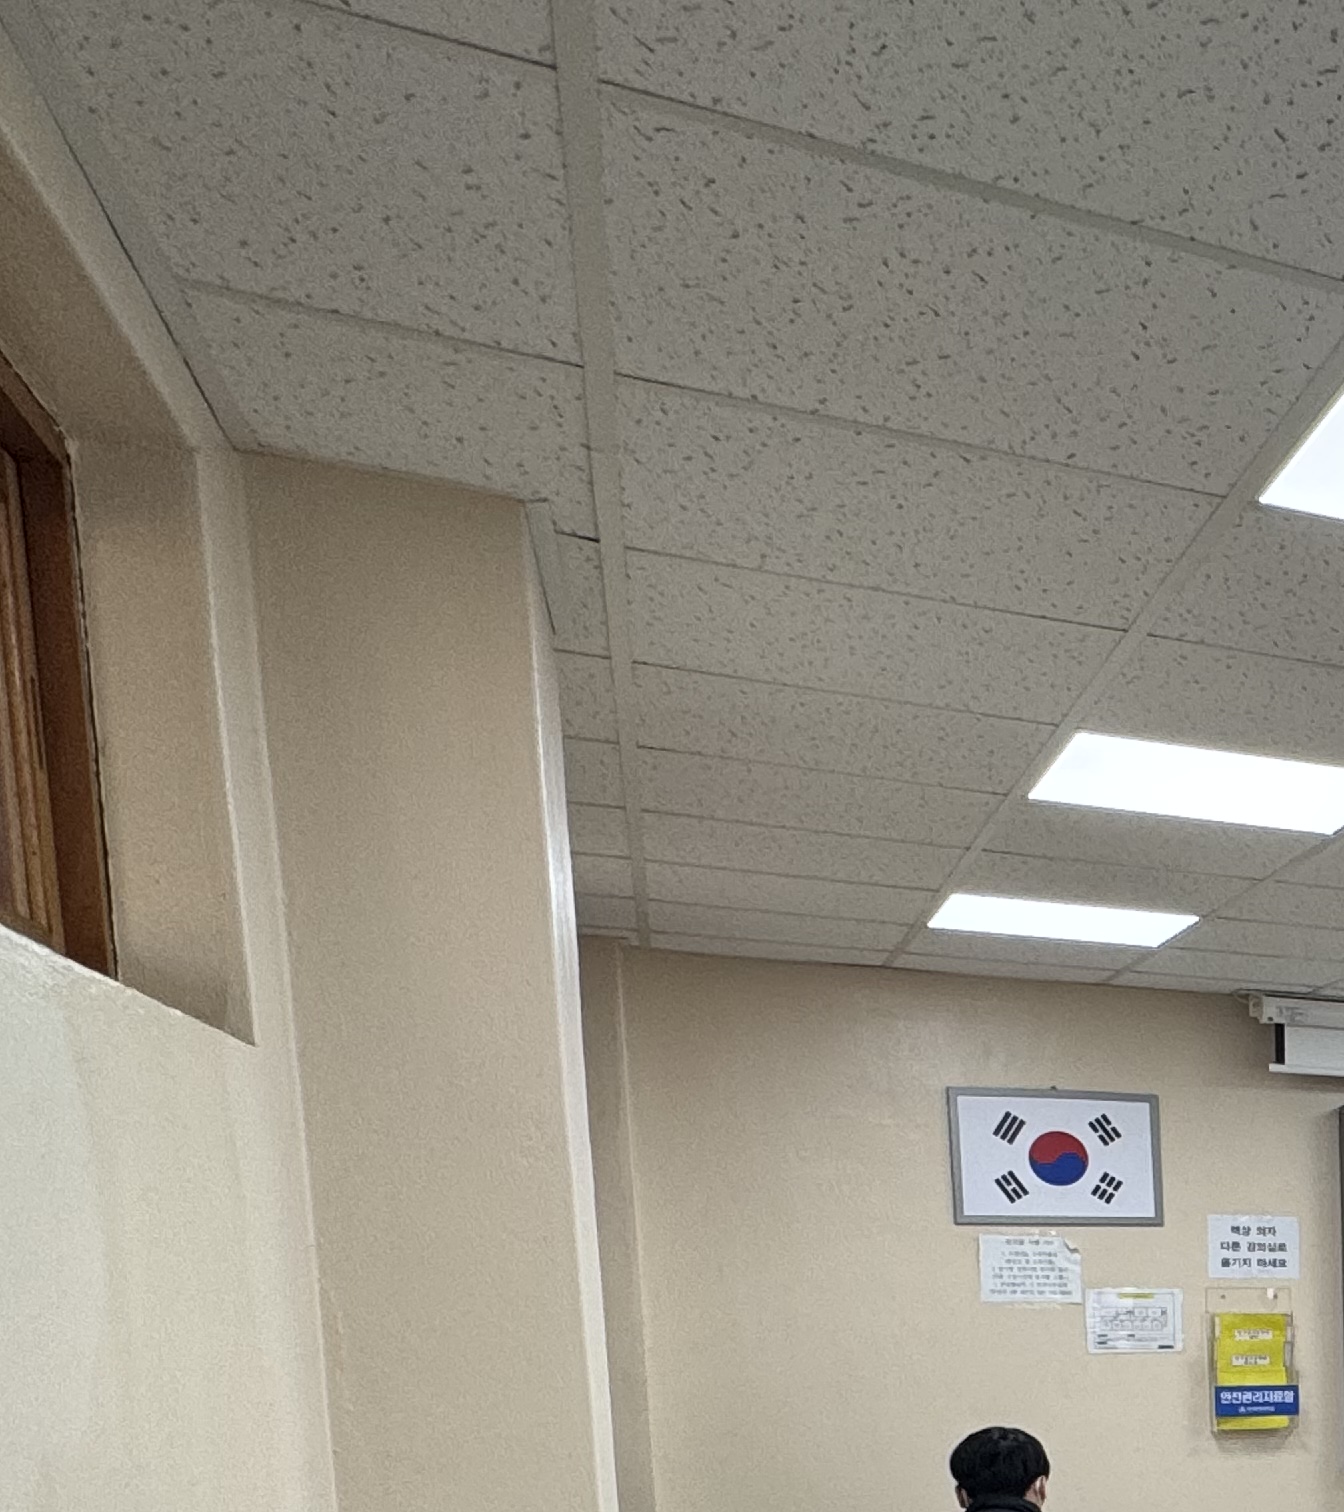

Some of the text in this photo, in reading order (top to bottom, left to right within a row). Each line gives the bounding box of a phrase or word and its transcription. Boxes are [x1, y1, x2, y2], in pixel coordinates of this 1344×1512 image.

[1220, 1241, 1288, 1252] 다른 강의실로
[1256, 1258, 1288, 1268] 마세요
